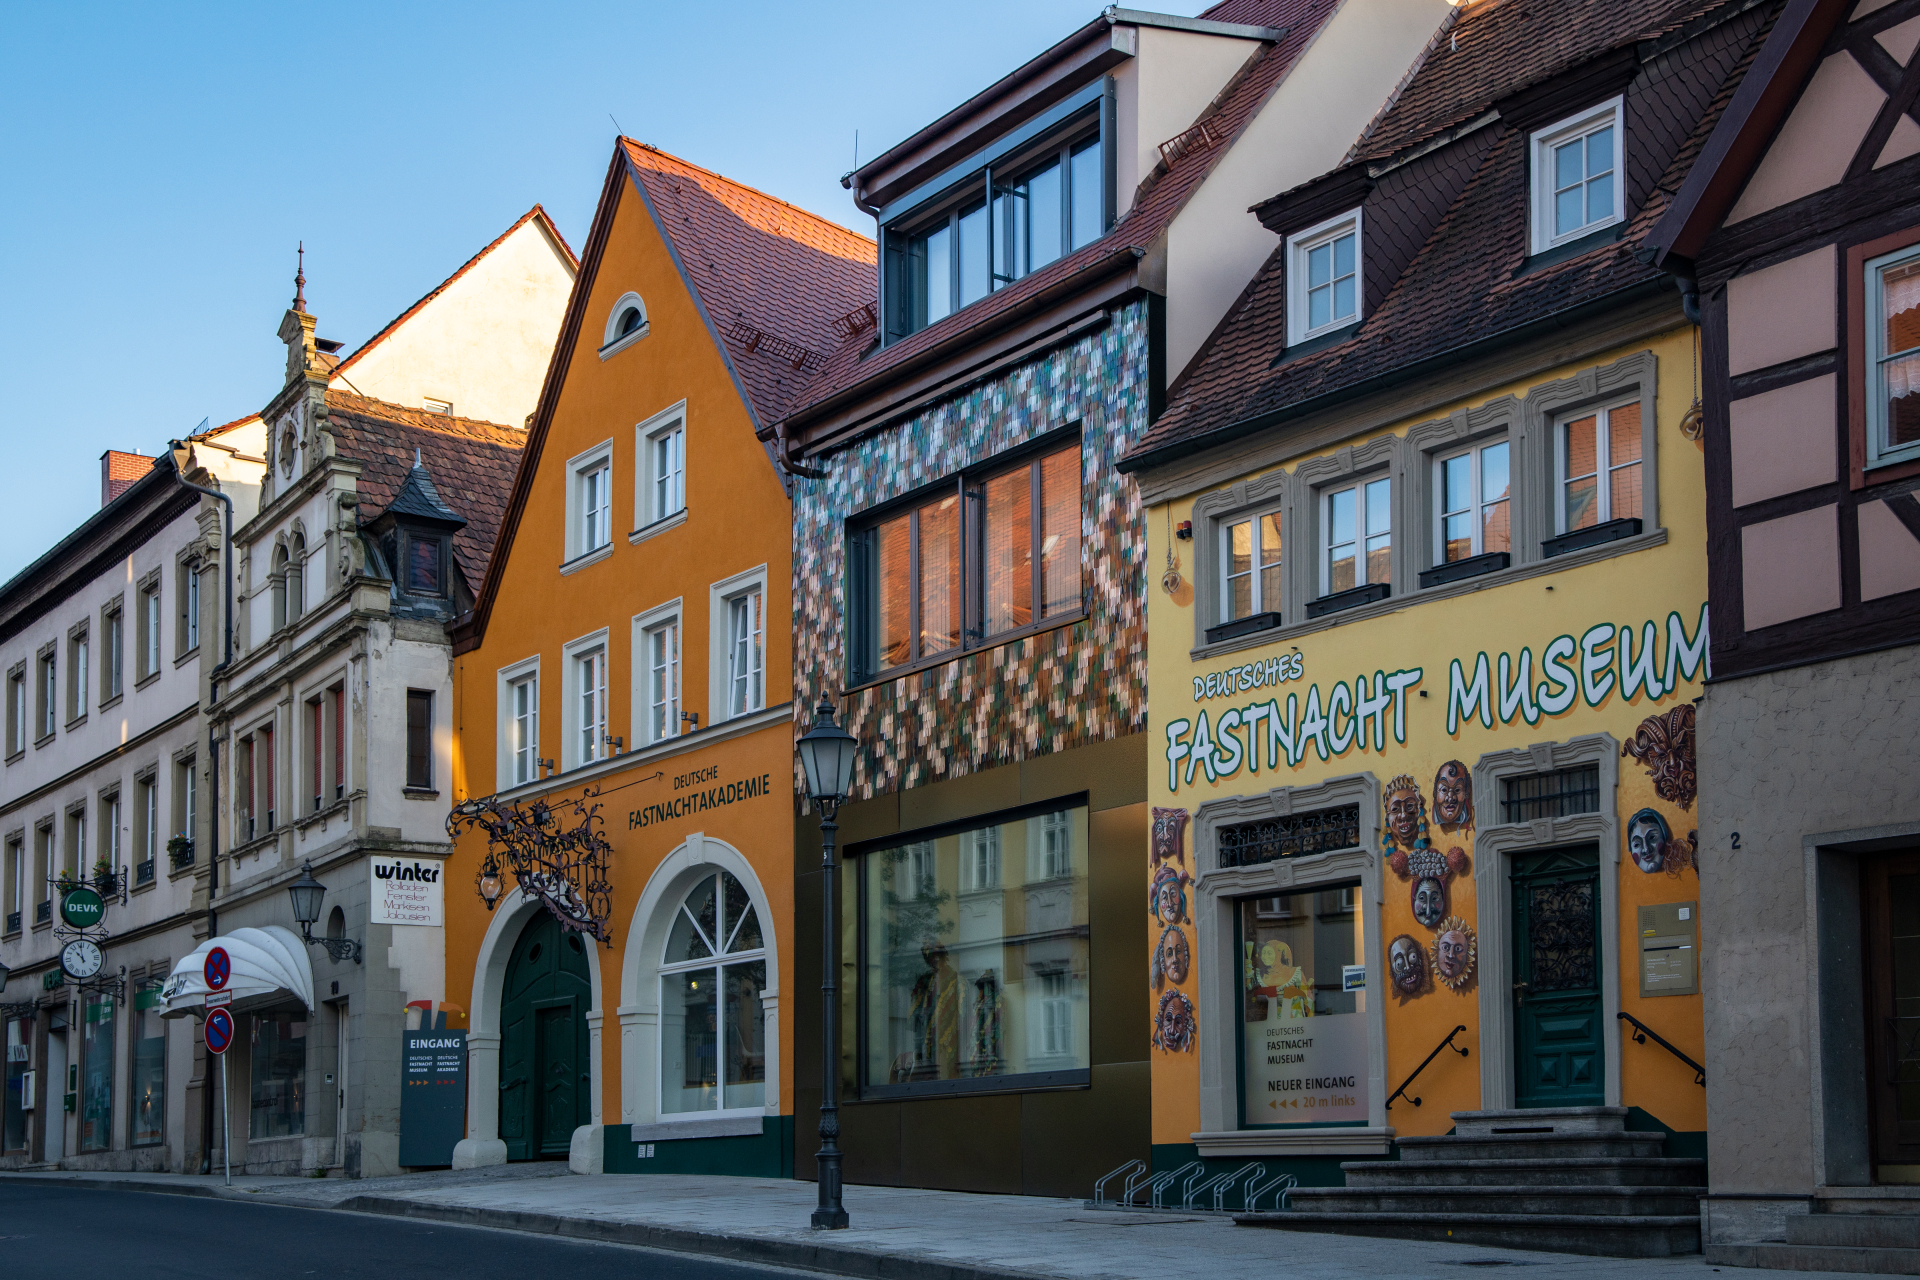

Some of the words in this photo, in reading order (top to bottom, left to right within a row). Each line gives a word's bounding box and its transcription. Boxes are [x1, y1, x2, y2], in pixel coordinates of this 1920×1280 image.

[1193, 652, 1304, 702] DEUTSCHES
[1166, 667, 1423, 792] FASTNACHT
[1446, 601, 1712, 735] MUSEUM
[674, 765, 718, 790] DEUTSCHE
[628, 773, 770, 831] FASTNACHTAKADEMIE
[1730, 831, 1741, 850] 2
[375, 861, 439, 883] winter
[385, 880, 429, 892] Rolladen
[387, 889, 427, 902] Fenster
[68, 904, 98, 913] DEVK
[383, 899, 430, 912] Markisen
[383, 909, 431, 921] Jalousien
[1266, 1026, 1304, 1037] DEUTSCHES
[410, 1038, 460, 1049] EINGANG
[1267, 1038, 1313, 1050] FASTNACHT
[1267, 1054, 1305, 1065] MUSEUM
[1268, 1079, 1302, 1091] NEUER
[1305, 1076, 1355, 1089] EINGANG
[1303, 1096, 1316, 1108] 20
[1319, 1099, 1328, 1107] m
[1331, 1094, 1355, 1107] links
